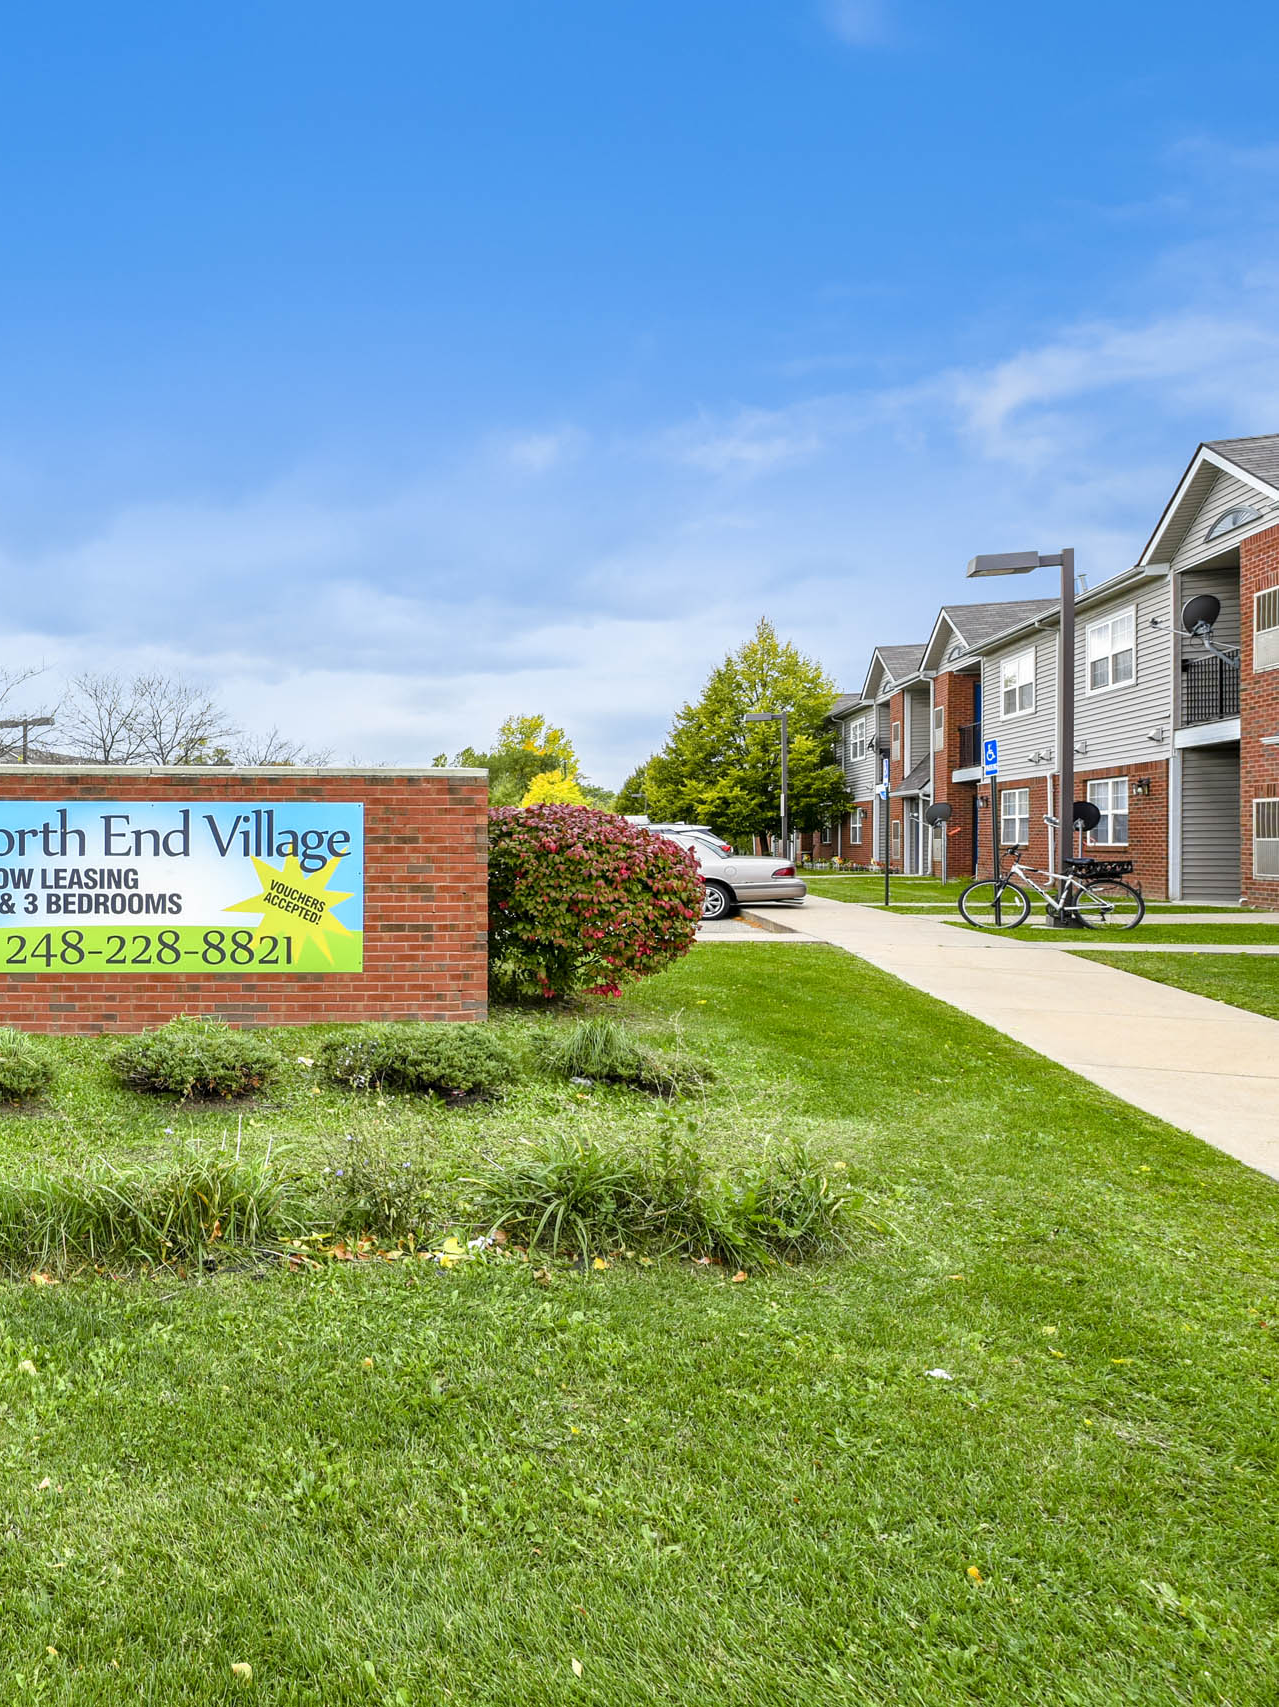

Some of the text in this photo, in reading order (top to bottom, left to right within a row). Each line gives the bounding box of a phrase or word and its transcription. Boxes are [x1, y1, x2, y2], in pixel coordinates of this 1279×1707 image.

[100, 808, 191, 858] End
[202, 808, 352, 874] Village
[41, 867, 139, 890] LEASING
[23, 893, 39, 915] 3
[46, 893, 183, 915] BEDROOMS
[263, 892, 322, 925] ACCEPTED!
[270, 879, 326, 912] VOUCHERS
[5, 929, 294, 966] 248-228-8821
